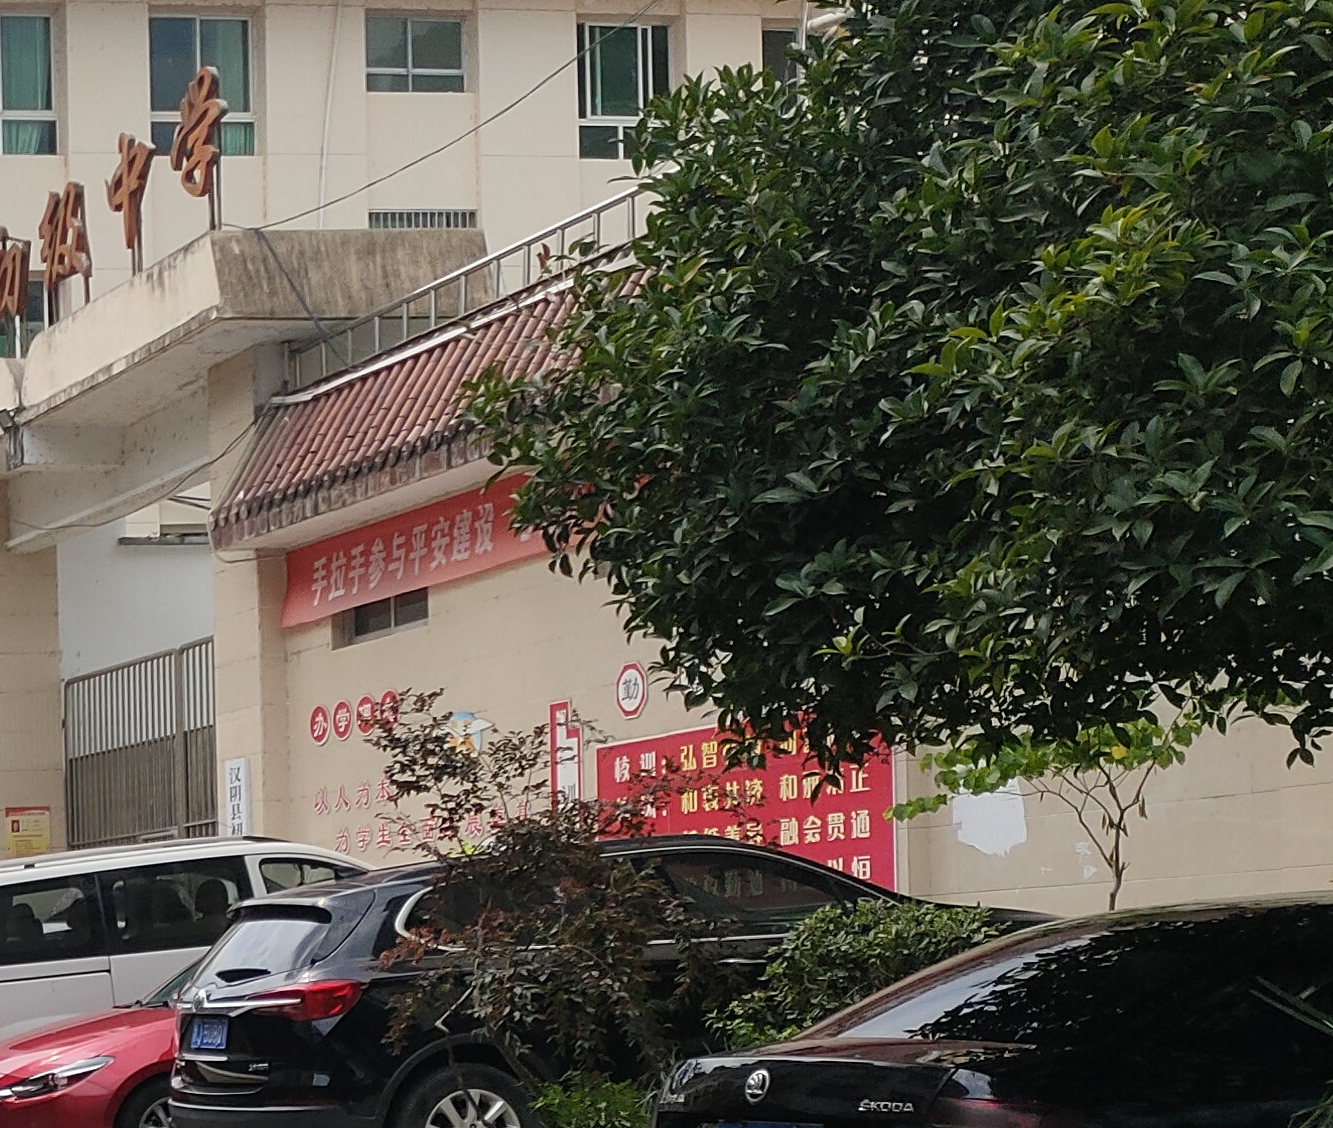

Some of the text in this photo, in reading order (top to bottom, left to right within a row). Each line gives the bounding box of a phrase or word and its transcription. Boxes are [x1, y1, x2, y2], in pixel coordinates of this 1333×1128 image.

[311, 503, 495, 607] 手拉手参与平安建设
[621, 677, 641, 701] 勤
[313, 778, 391, 815] 以人为本
[780, 810, 871, 846] 融会贯通
